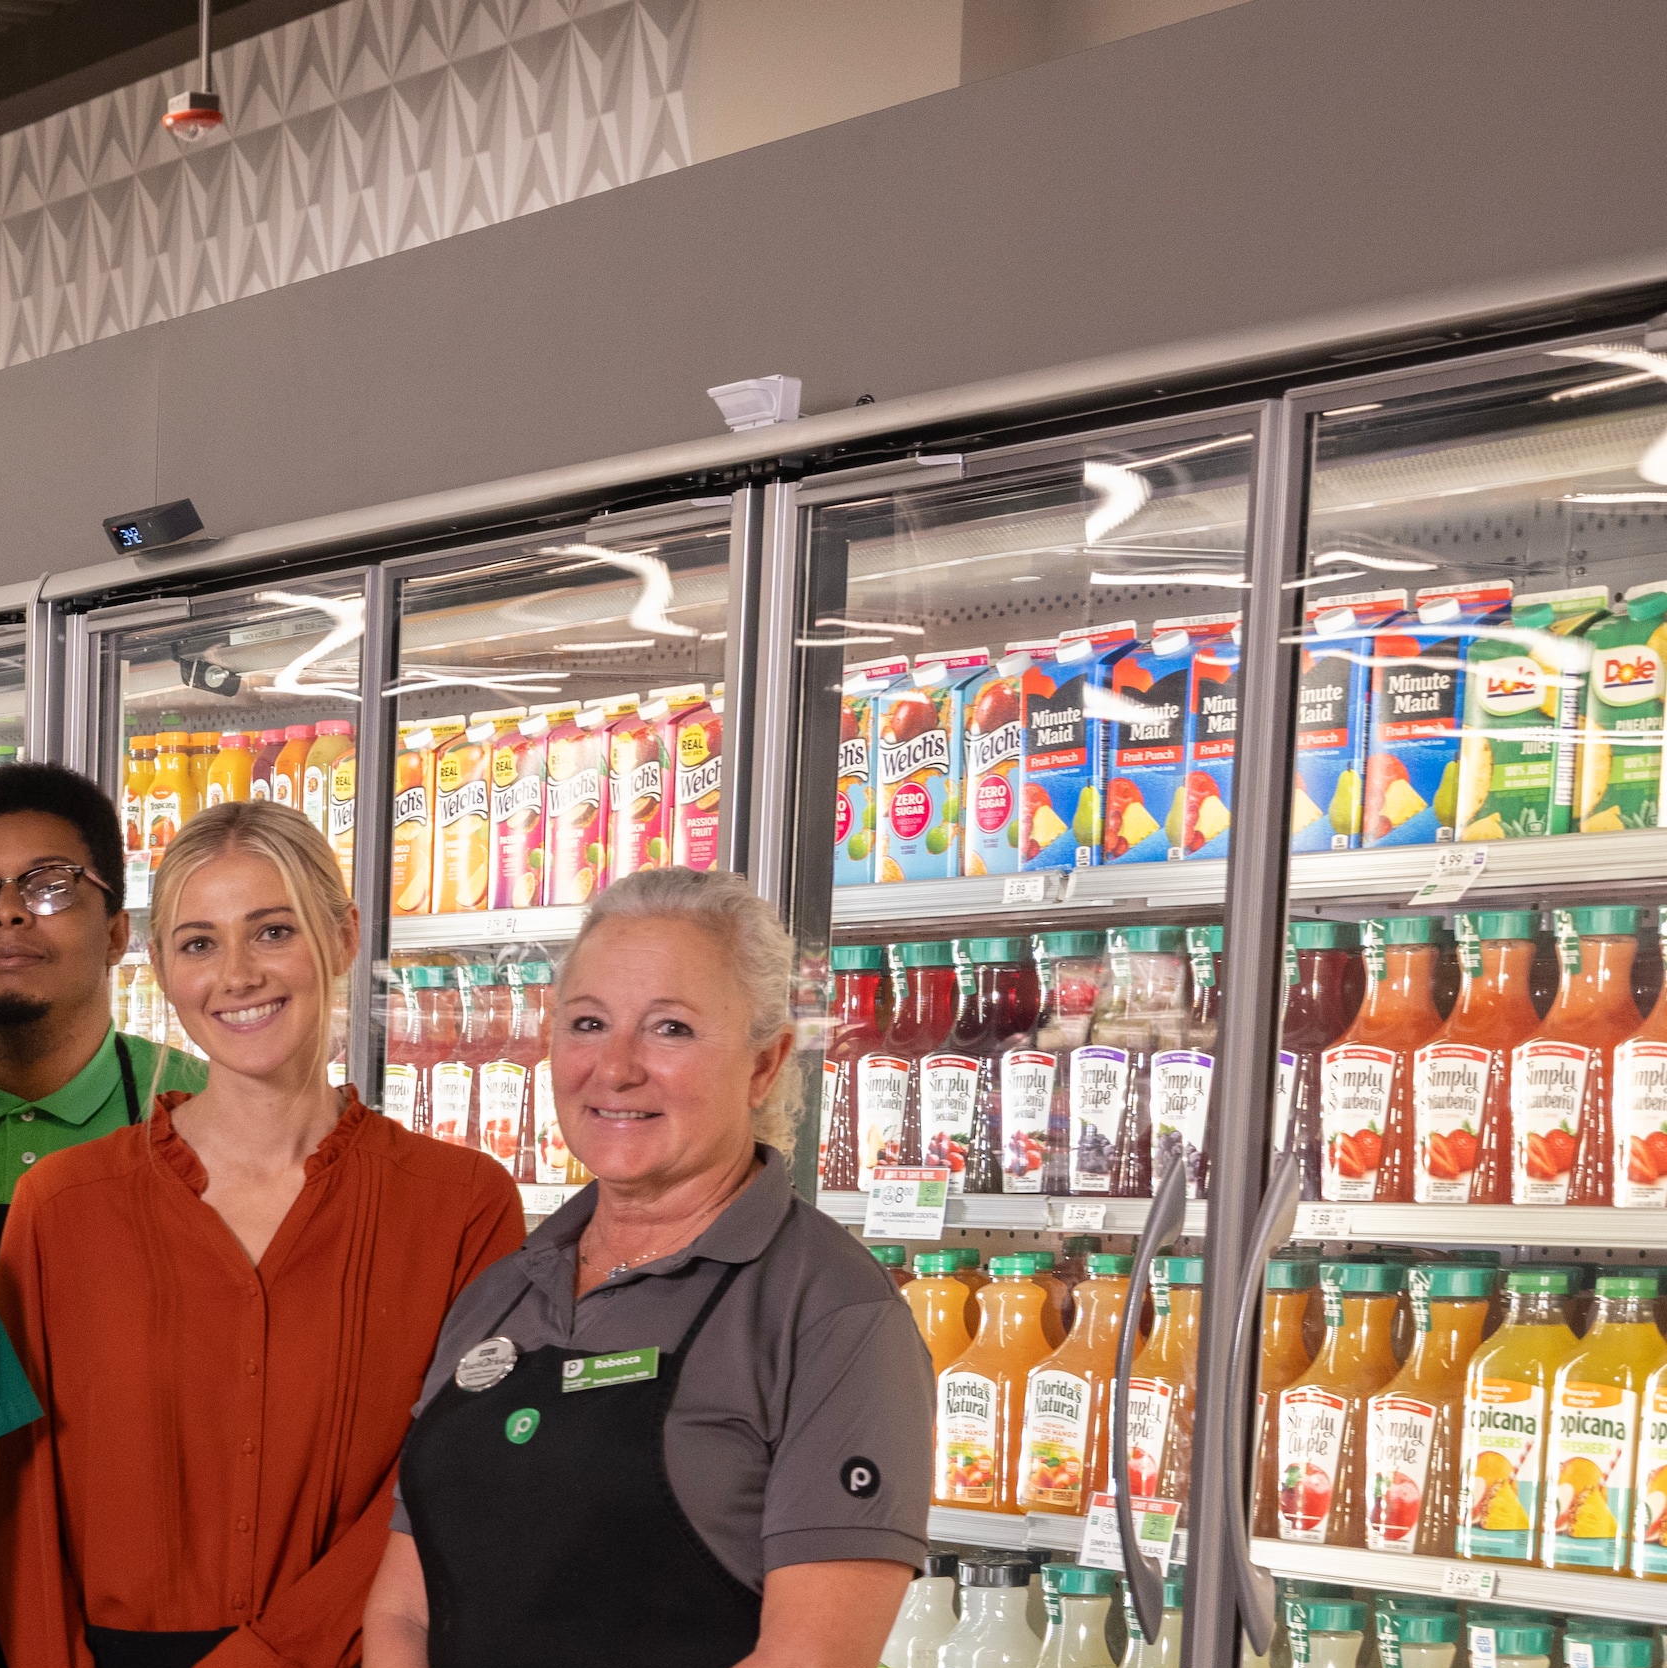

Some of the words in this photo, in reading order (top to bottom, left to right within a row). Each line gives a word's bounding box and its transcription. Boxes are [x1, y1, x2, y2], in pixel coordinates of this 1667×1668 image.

[1604, 656, 1655, 682] Dole
[1388, 672, 1450, 695] Minute
[1393, 692, 1440, 714] Maid
[1031, 707, 1081, 728] Minute
[1036, 727, 1074, 746] Maid
[1130, 723, 1169, 741] Maid
[1385, 725, 1410, 737] Fruit
[681, 739, 703, 750] REAL
[1308, 732, 1338, 745] Punch
[883, 734, 945, 776] Welch's
[1123, 752, 1142, 763] Fruit
[1145, 749, 1174, 761] Punch
[1200, 744, 1219, 755] Fruit
[495, 761, 513, 772] REAL
[1031, 756, 1049, 768] Fruit
[1050, 753, 1078, 764] Punch
[440, 766, 458, 777] REAL
[335, 775, 351, 787] REAL
[978, 785, 1007, 798] ZERO
[439, 785, 485, 820] Welch's
[896, 792, 925, 806] ZERO
[978, 796, 1006, 808] SUGAR
[895, 805, 924, 816] SUGAR
[691, 827, 713, 838] FRUIT
[1439, 854, 1463, 867] 4.99
[595, 1355, 642, 1370] Rebecca
[946, 1399, 988, 1419] Natural
[1035, 1397, 1079, 1420] Natural
[1053, 1429, 1078, 1439] MANGO
[1090, 1539, 1112, 1548] SIMPLY
[1448, 1571, 1470, 1586] 3.69
